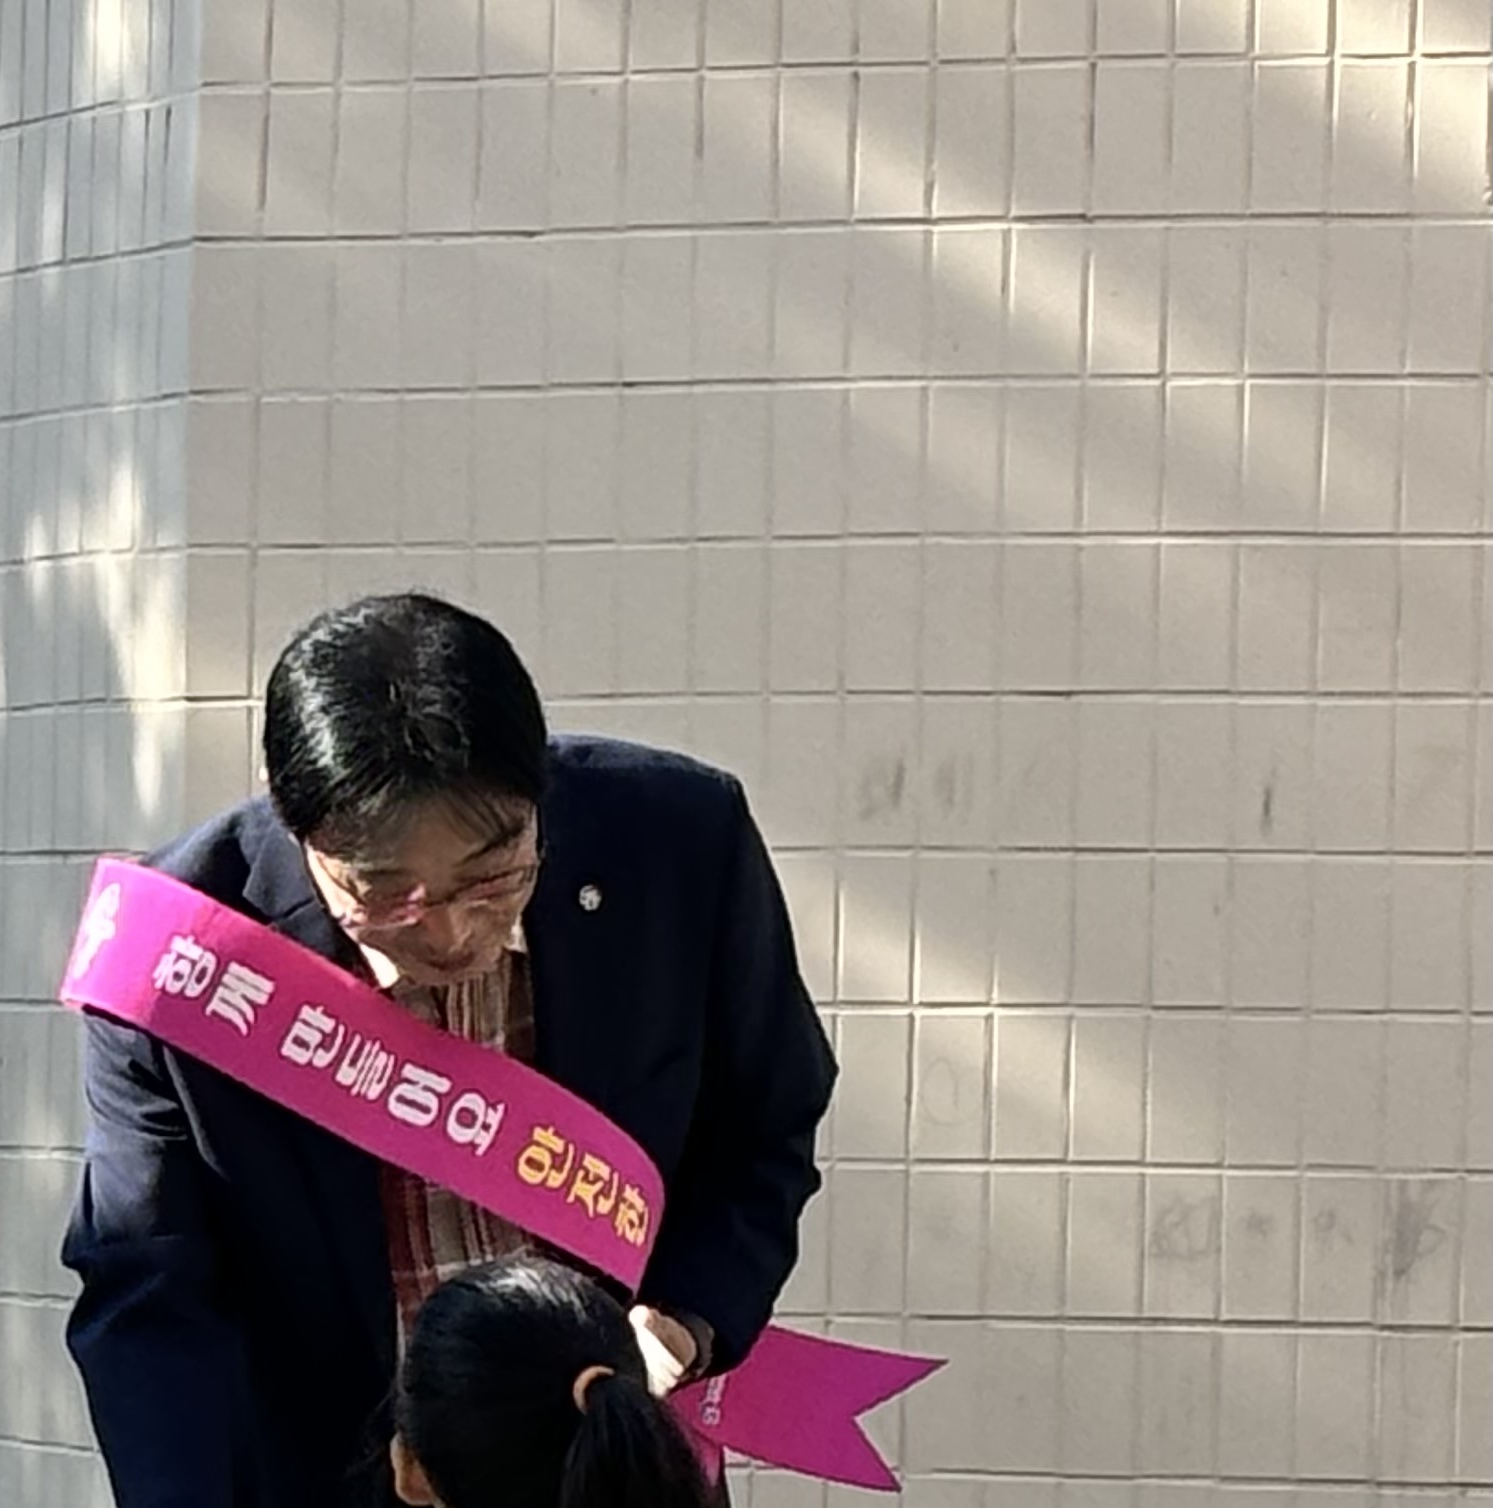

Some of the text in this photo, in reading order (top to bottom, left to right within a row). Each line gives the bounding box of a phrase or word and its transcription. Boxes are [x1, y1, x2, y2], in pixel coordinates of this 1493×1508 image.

[152, 934, 648, 1246] 함께 만들어요 안전한
